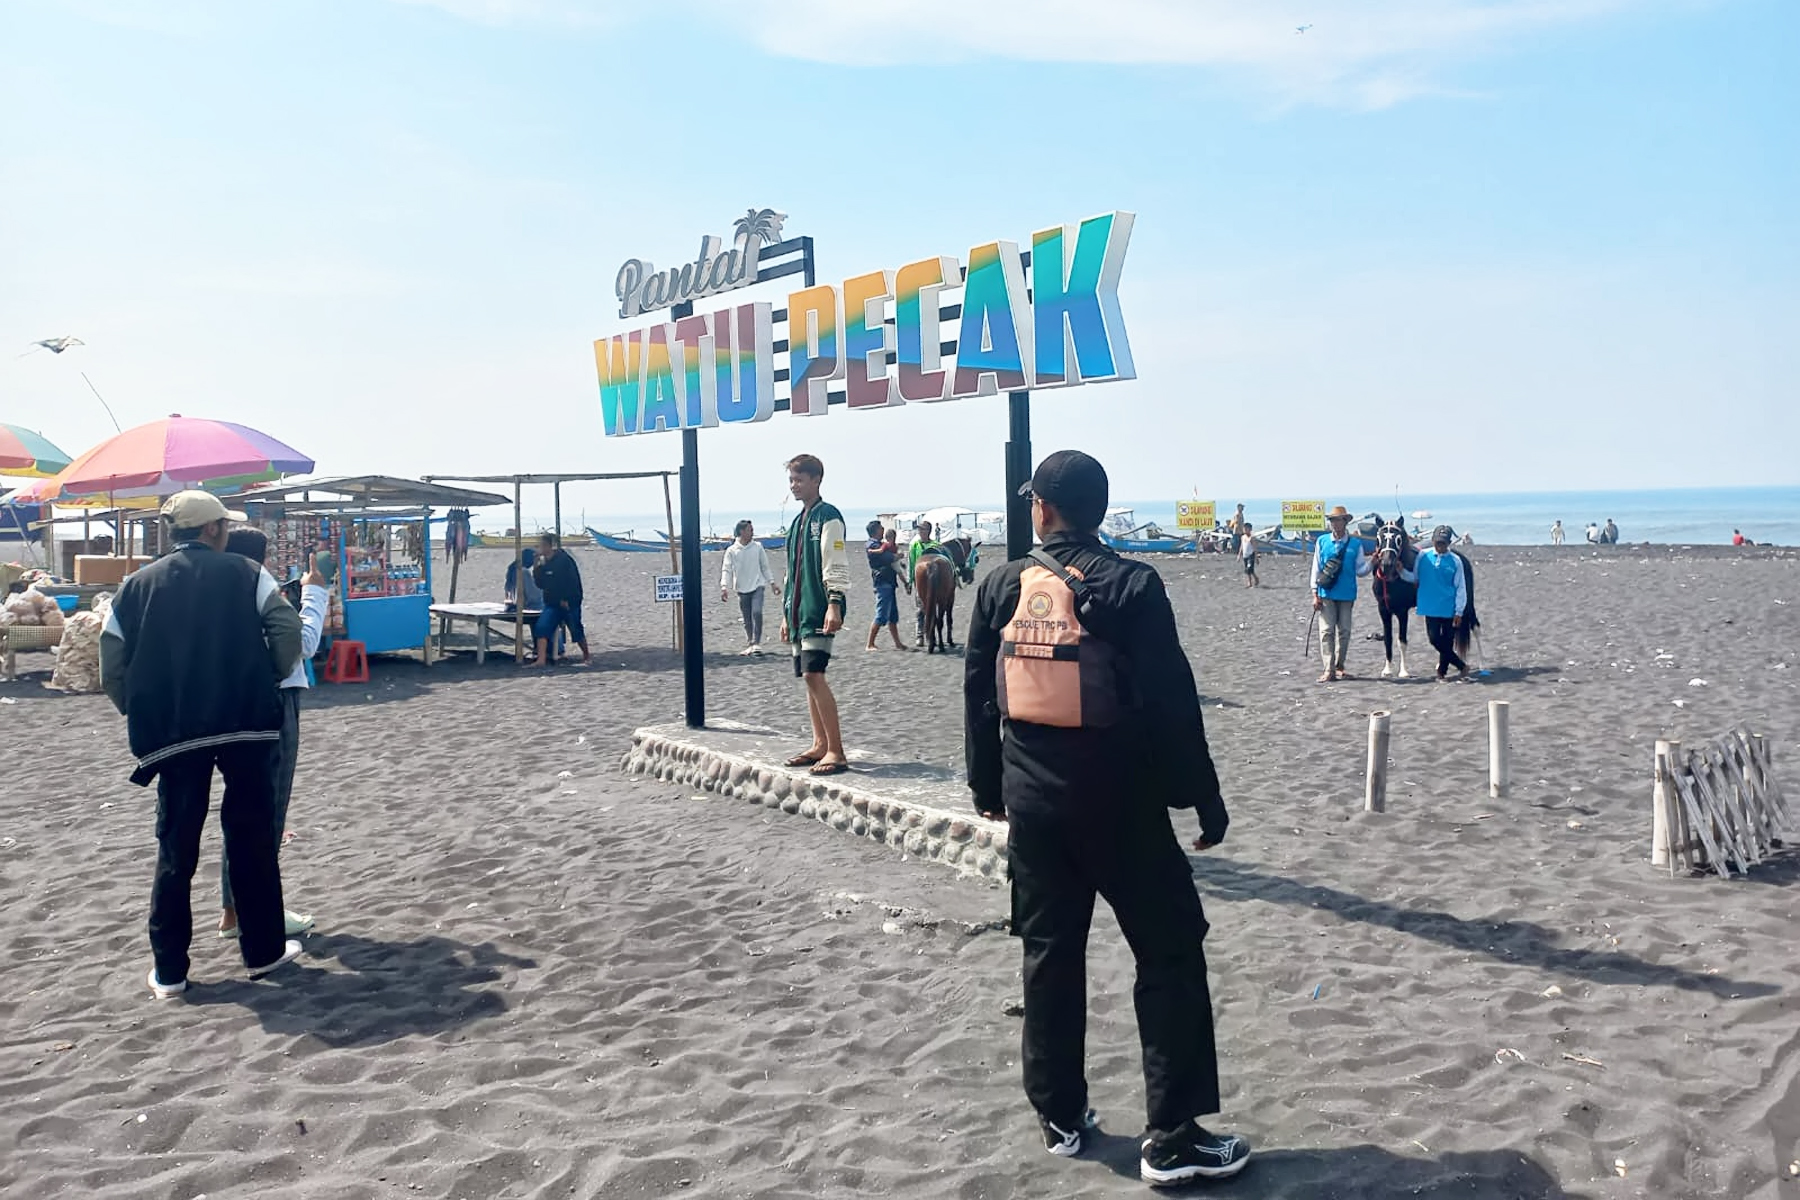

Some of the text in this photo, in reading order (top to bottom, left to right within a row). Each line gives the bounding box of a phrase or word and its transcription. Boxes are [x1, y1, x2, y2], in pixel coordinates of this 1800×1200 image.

[594, 210, 1137, 437] WATU PECAK
[1041, 620, 1055, 630] TRC
